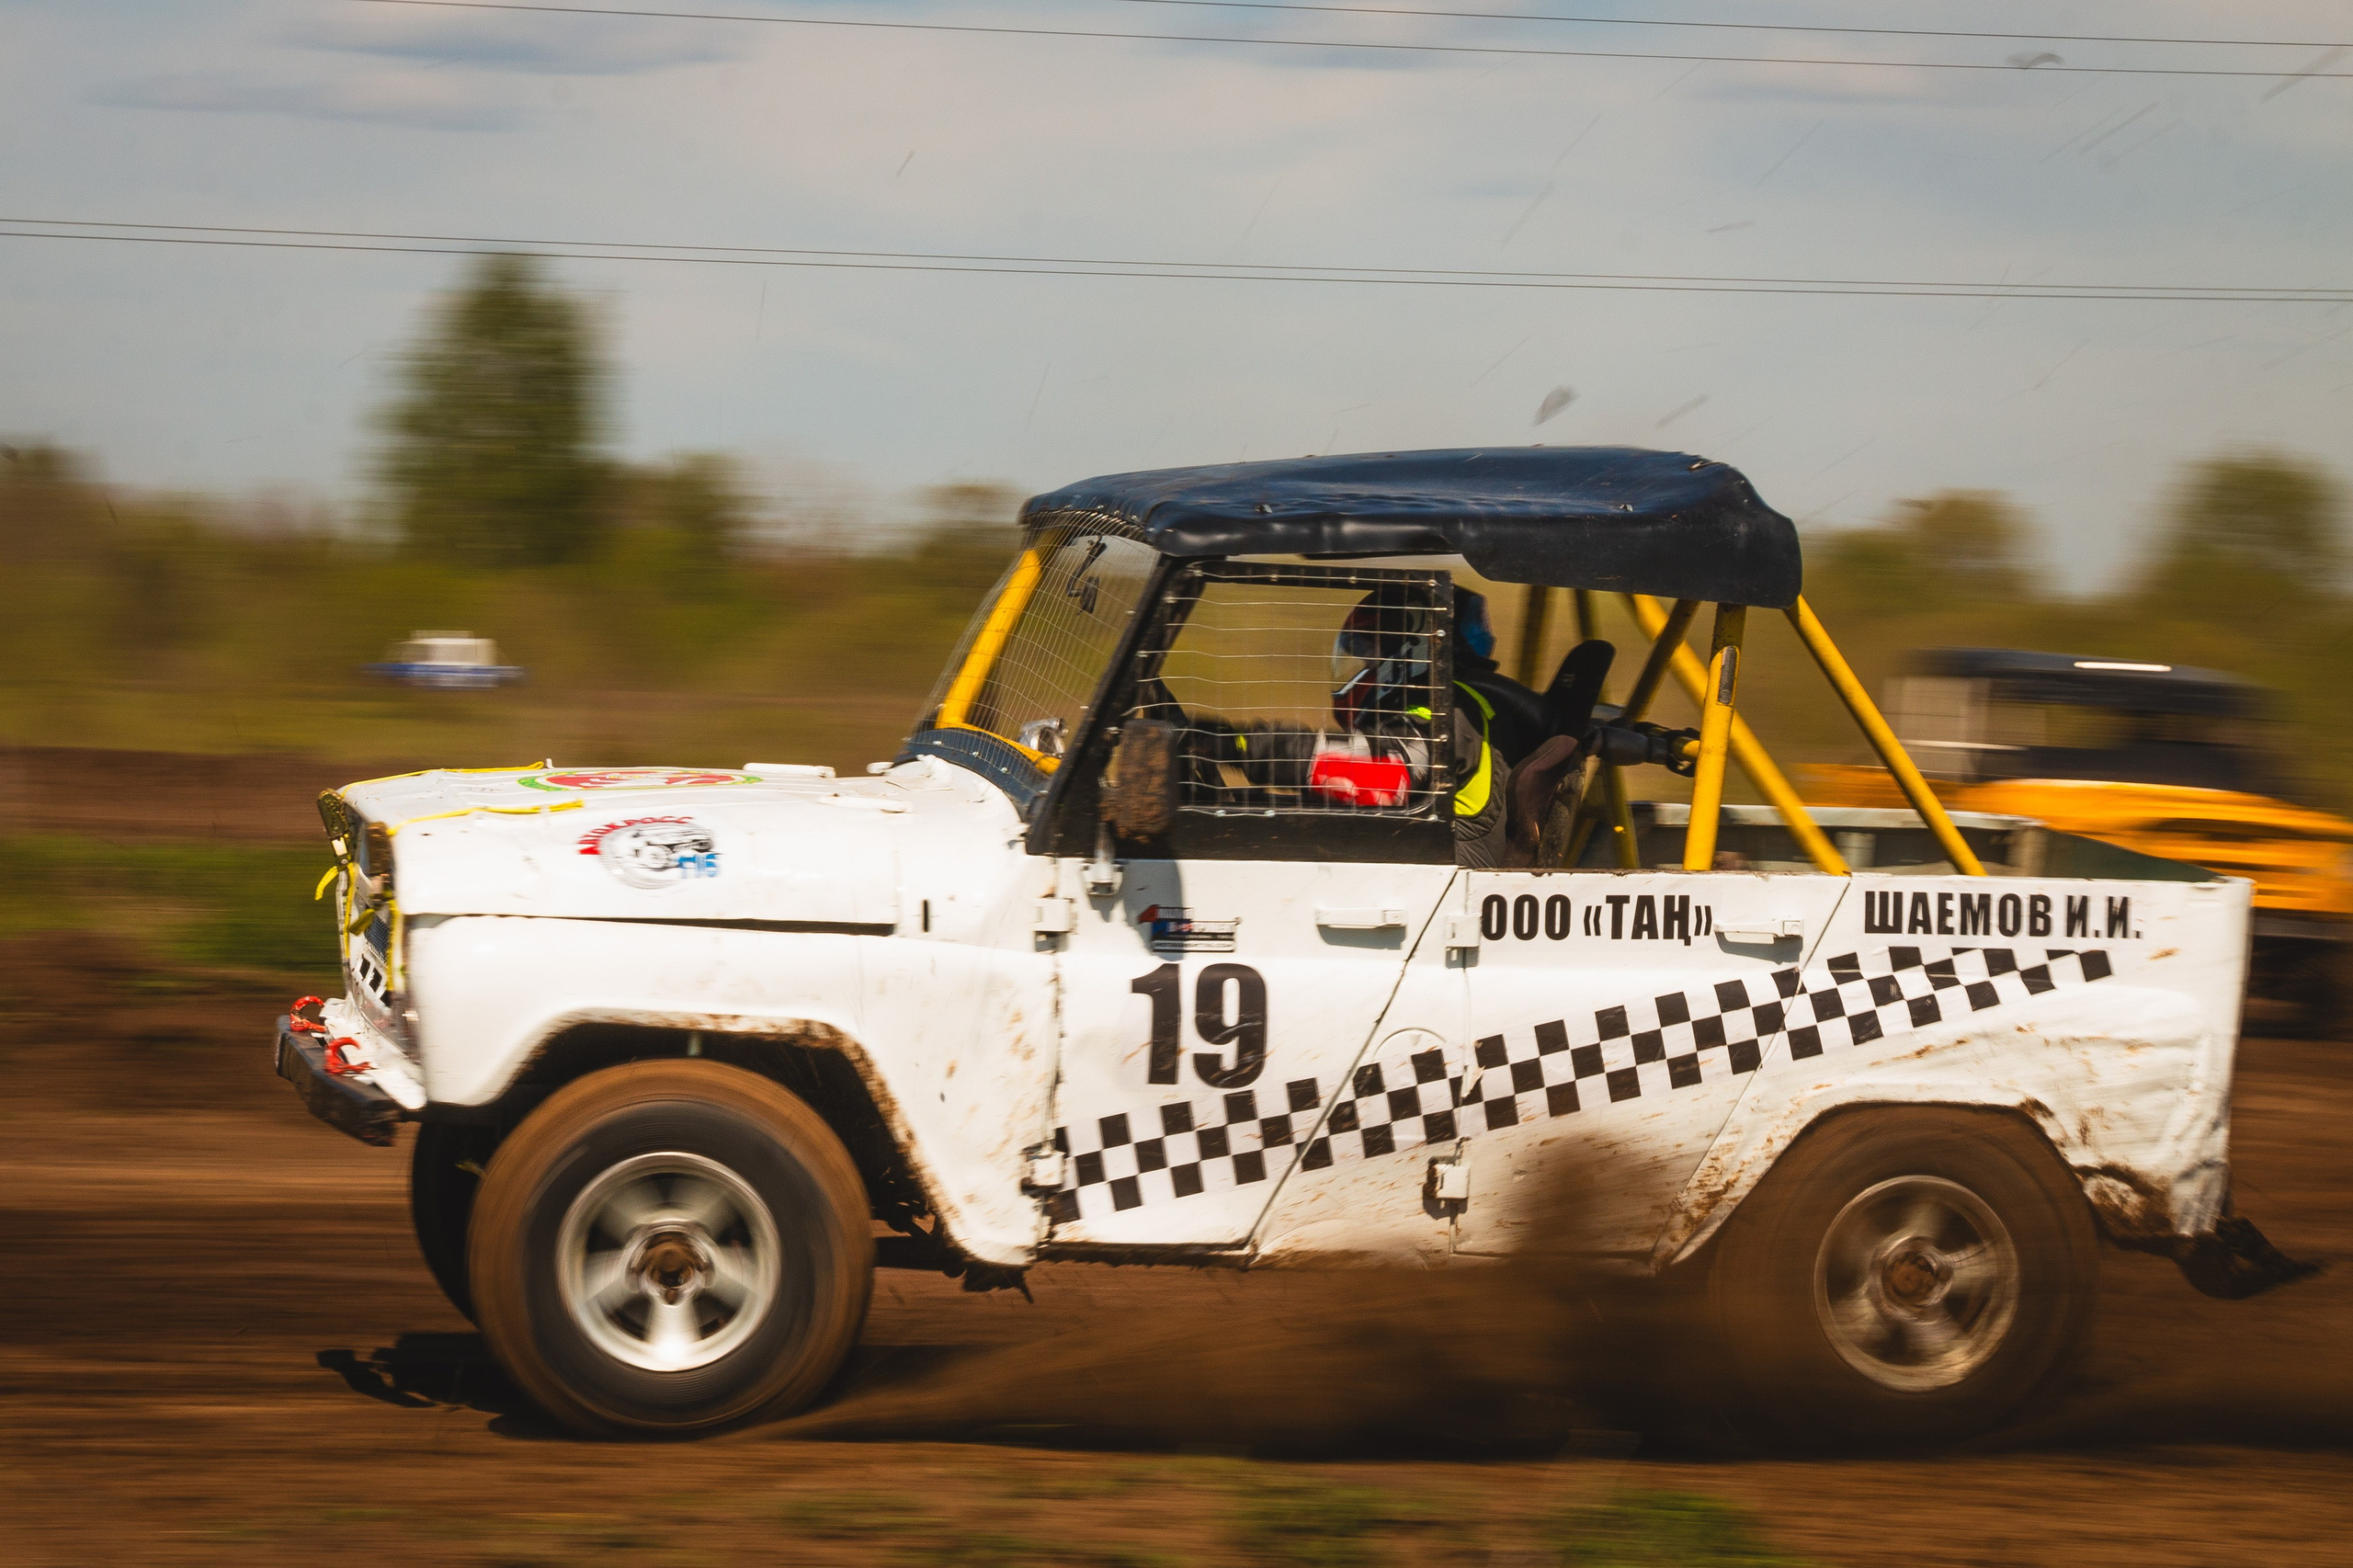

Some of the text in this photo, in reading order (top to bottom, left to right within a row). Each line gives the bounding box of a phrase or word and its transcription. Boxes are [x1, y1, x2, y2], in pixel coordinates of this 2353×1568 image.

[1481, 893, 1572, 941] ООО
[1864, 891, 2144, 939] ШАЕМОВ И.И.
[1131, 962, 1267, 1090] 19
